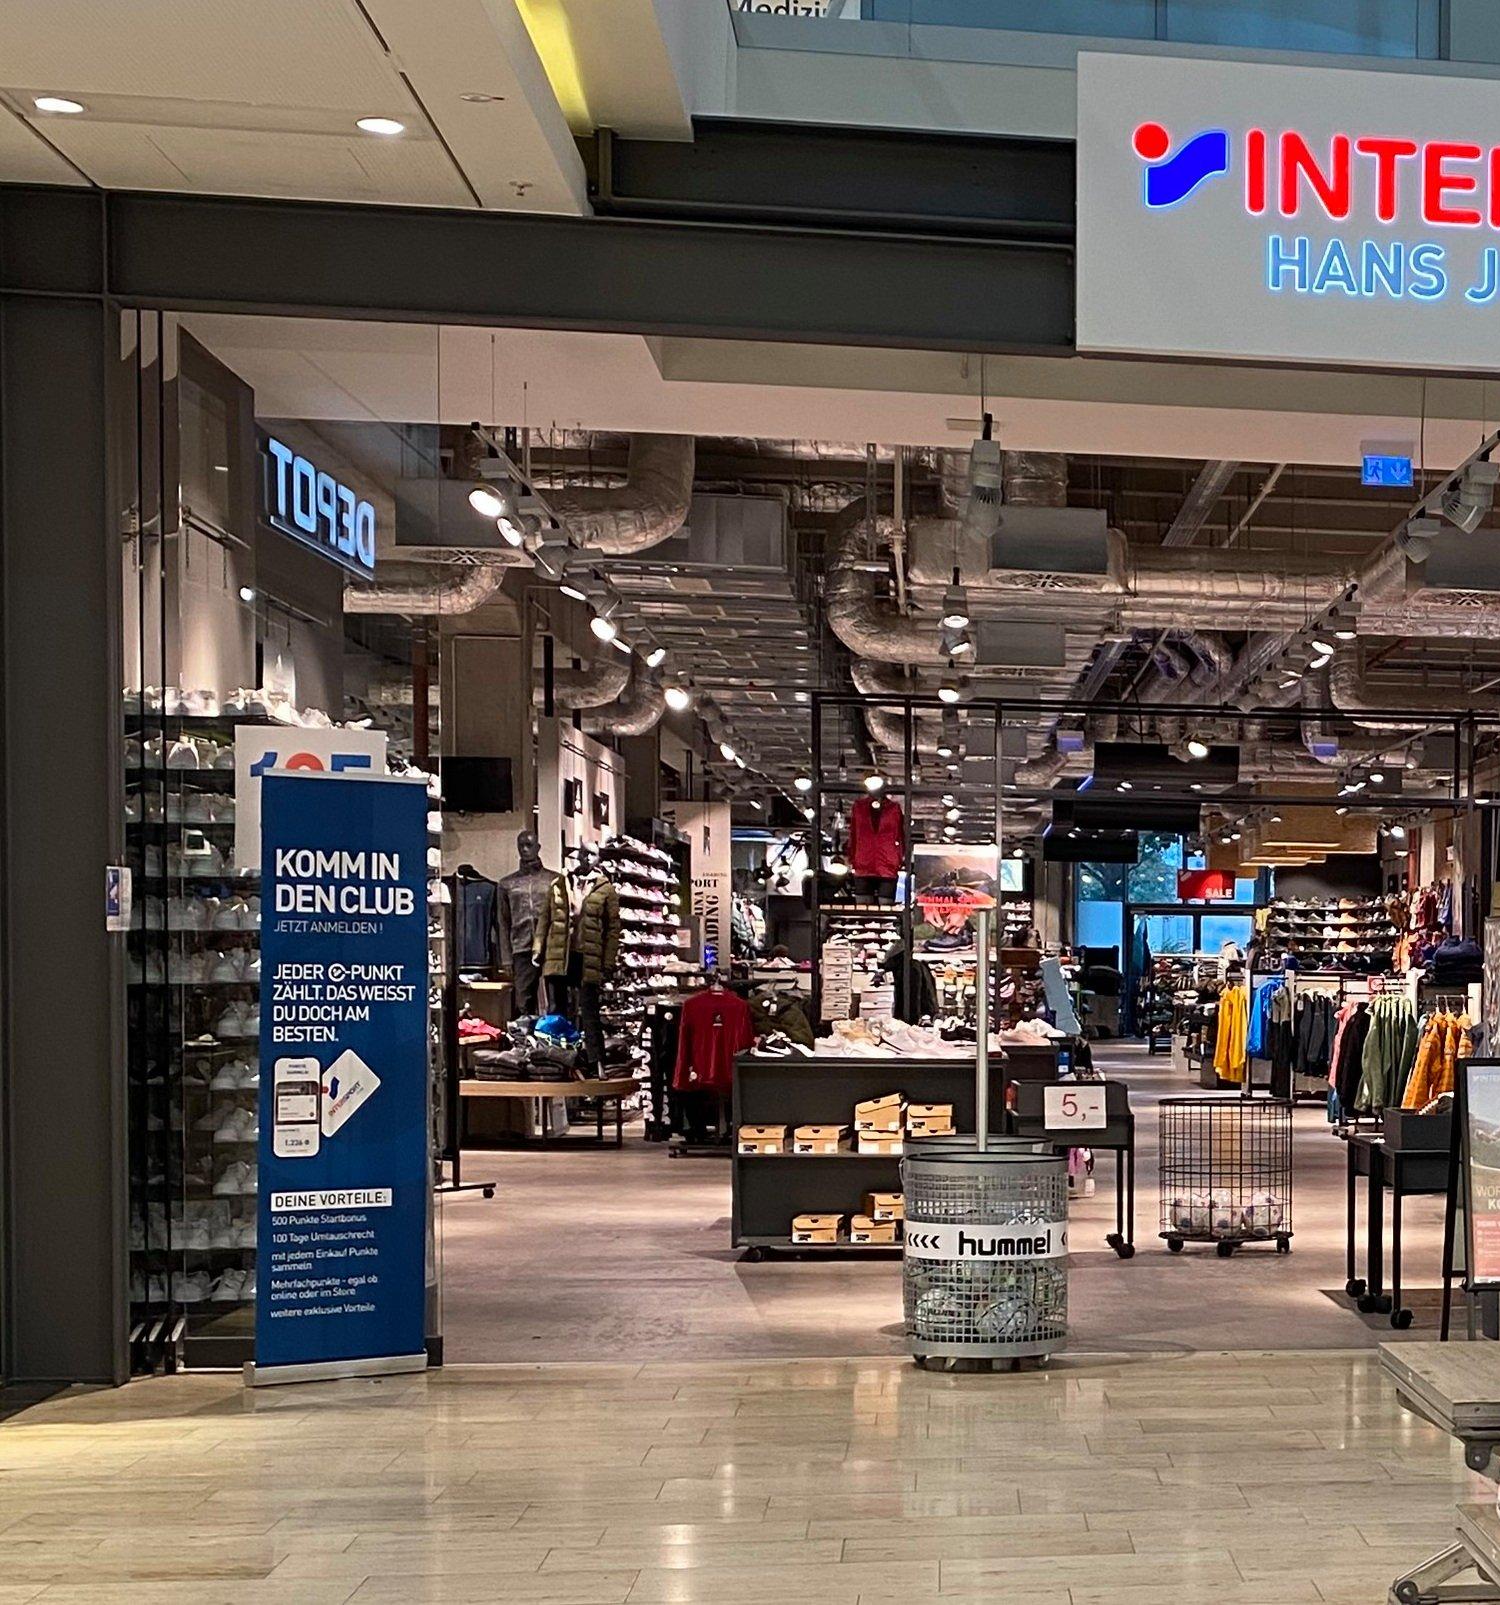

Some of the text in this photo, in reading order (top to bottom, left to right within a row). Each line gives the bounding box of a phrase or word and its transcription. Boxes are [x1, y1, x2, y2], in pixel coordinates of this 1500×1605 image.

[1267, 234, 1448, 300] HANS
[276, 848, 400, 881] KOMM IN
[275, 884, 415, 915] DEN CLUB
[1205, 888, 1233, 899] SALE
[274, 920, 309, 933] JETZT
[310, 921, 377, 934] ANMELDEN
[272, 964, 325, 980] JEDER
[272, 981, 416, 1001] ZÄHLT. DAS WEISST
[273, 1005, 370, 1021] DU DOCH AM
[272, 1026, 339, 1042] BESTEN.
[275, 1191, 387, 1208] DEINE VORTEILE:
[272, 1213, 367, 1226] 500 Punkte Startbonus
[272, 1230, 375, 1244] 100 Tage Umtauschrecht
[958, 1229, 1051, 1256] hummel
[271, 1246, 379, 1262] mit jedem Einkauf Punkte
[271, 1261, 312, 1273] sammeln
[347, 1274, 367, 1287] egal
[271, 1286, 356, 1301] online oder im Store
[270, 1302, 376, 1318] weitere exklusive Vorteile
